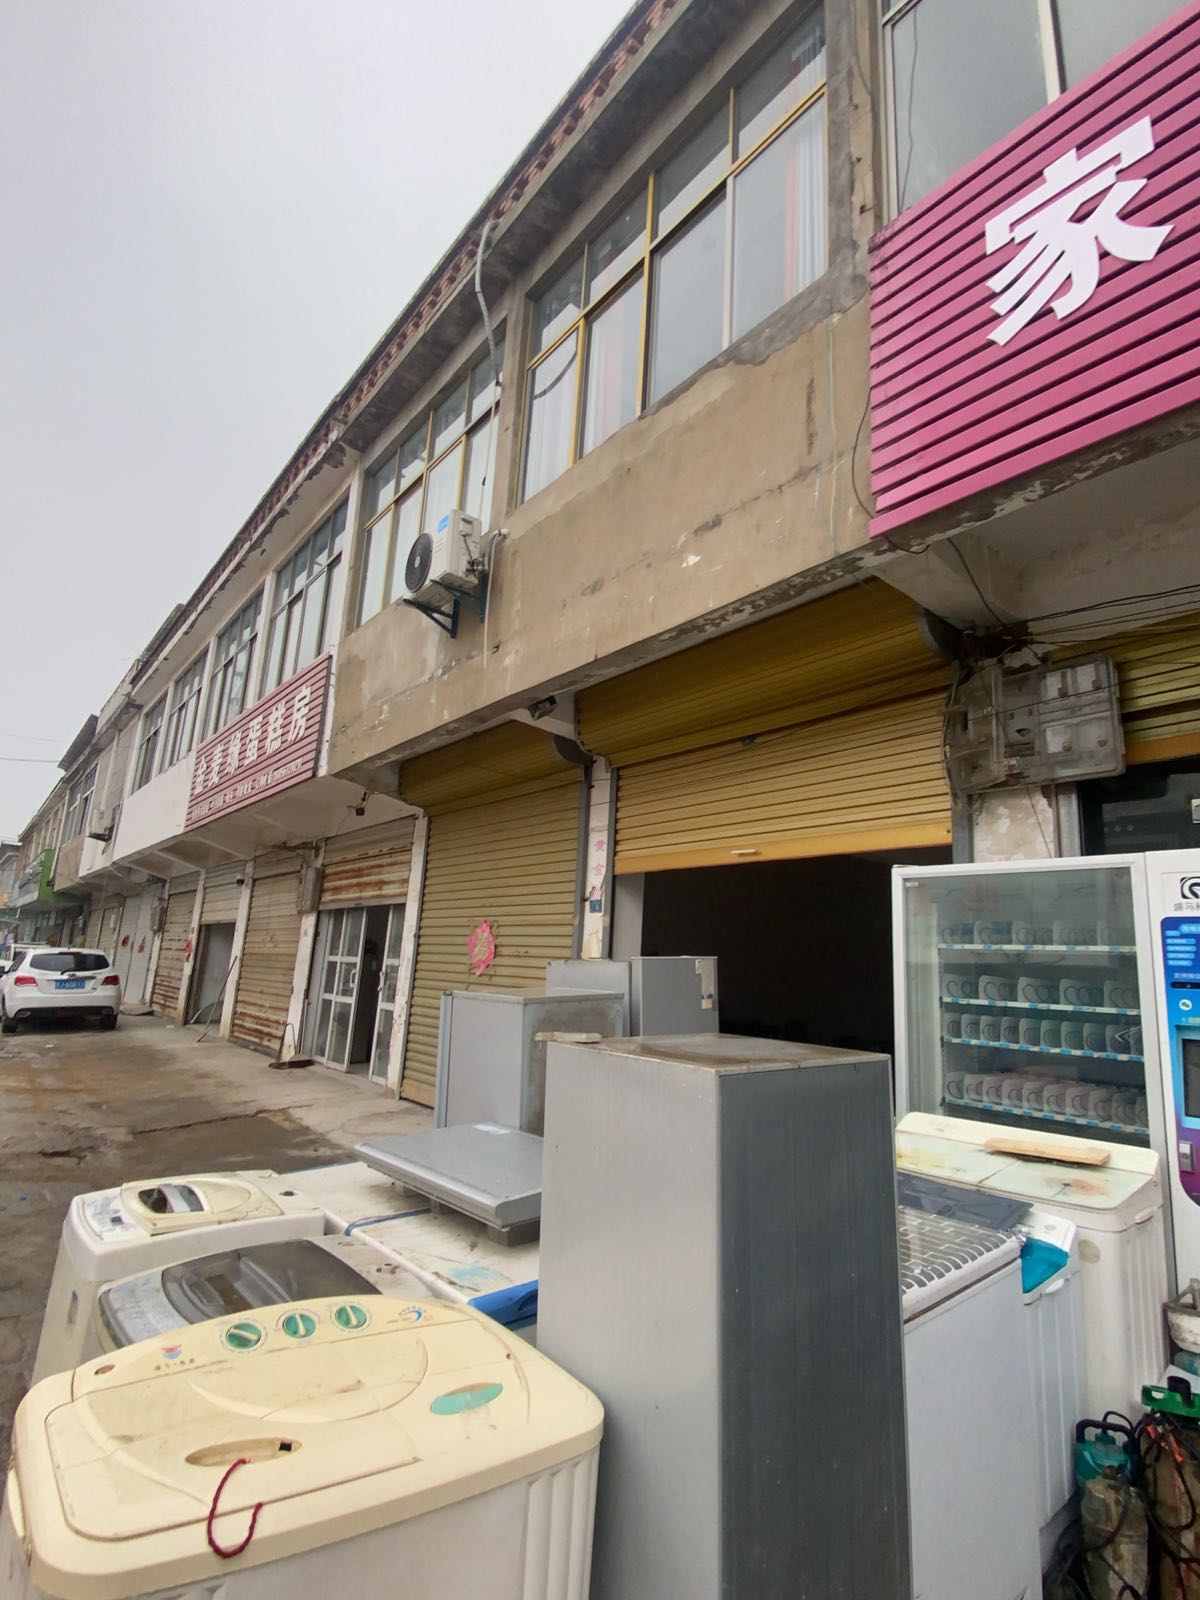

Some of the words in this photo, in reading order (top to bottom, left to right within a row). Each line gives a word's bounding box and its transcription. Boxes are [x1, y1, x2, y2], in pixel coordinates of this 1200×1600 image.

[985, 115, 1175, 346] 家
[194, 684, 312, 796] 金麦缘蛋糕房
